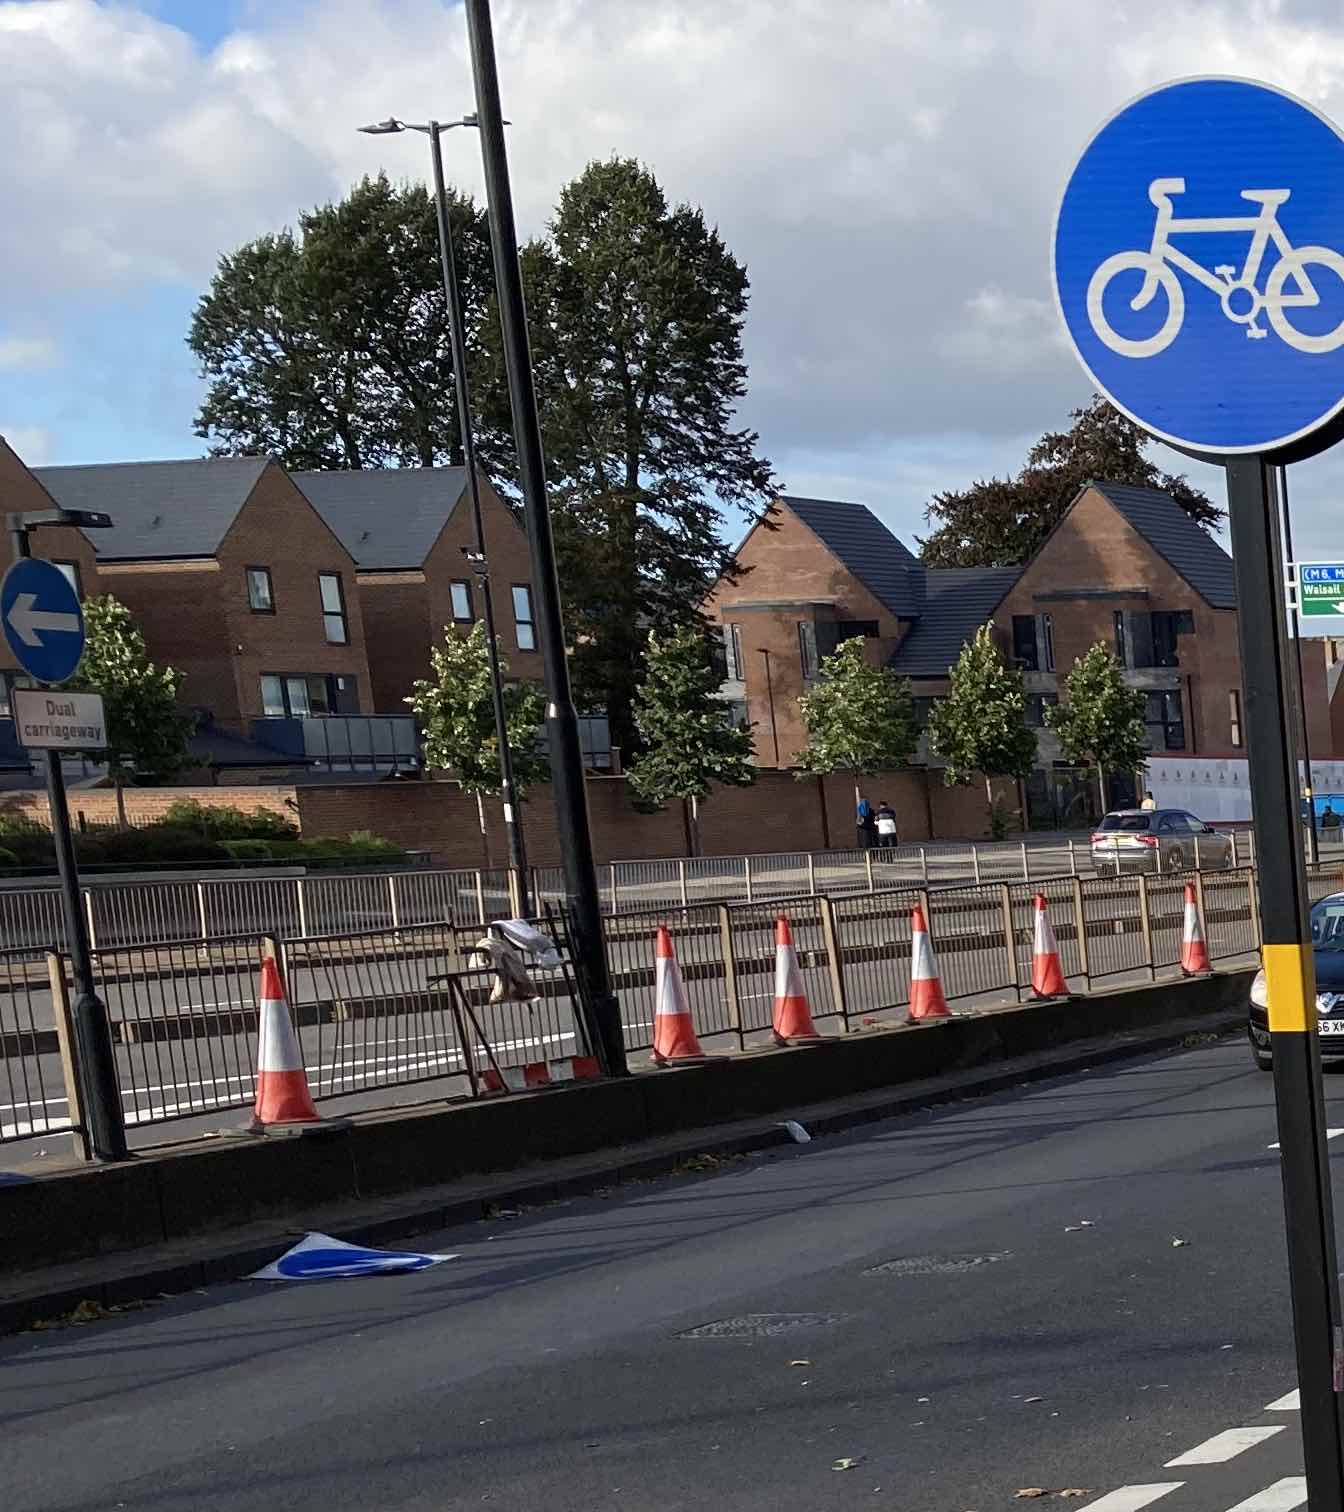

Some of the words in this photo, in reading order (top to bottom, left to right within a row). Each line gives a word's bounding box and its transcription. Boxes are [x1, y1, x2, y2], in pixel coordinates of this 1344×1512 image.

[1303, 584, 1341, 595] Walsall
[45, 699, 76, 717] Dual
[24, 721, 101, 741] carriageway
